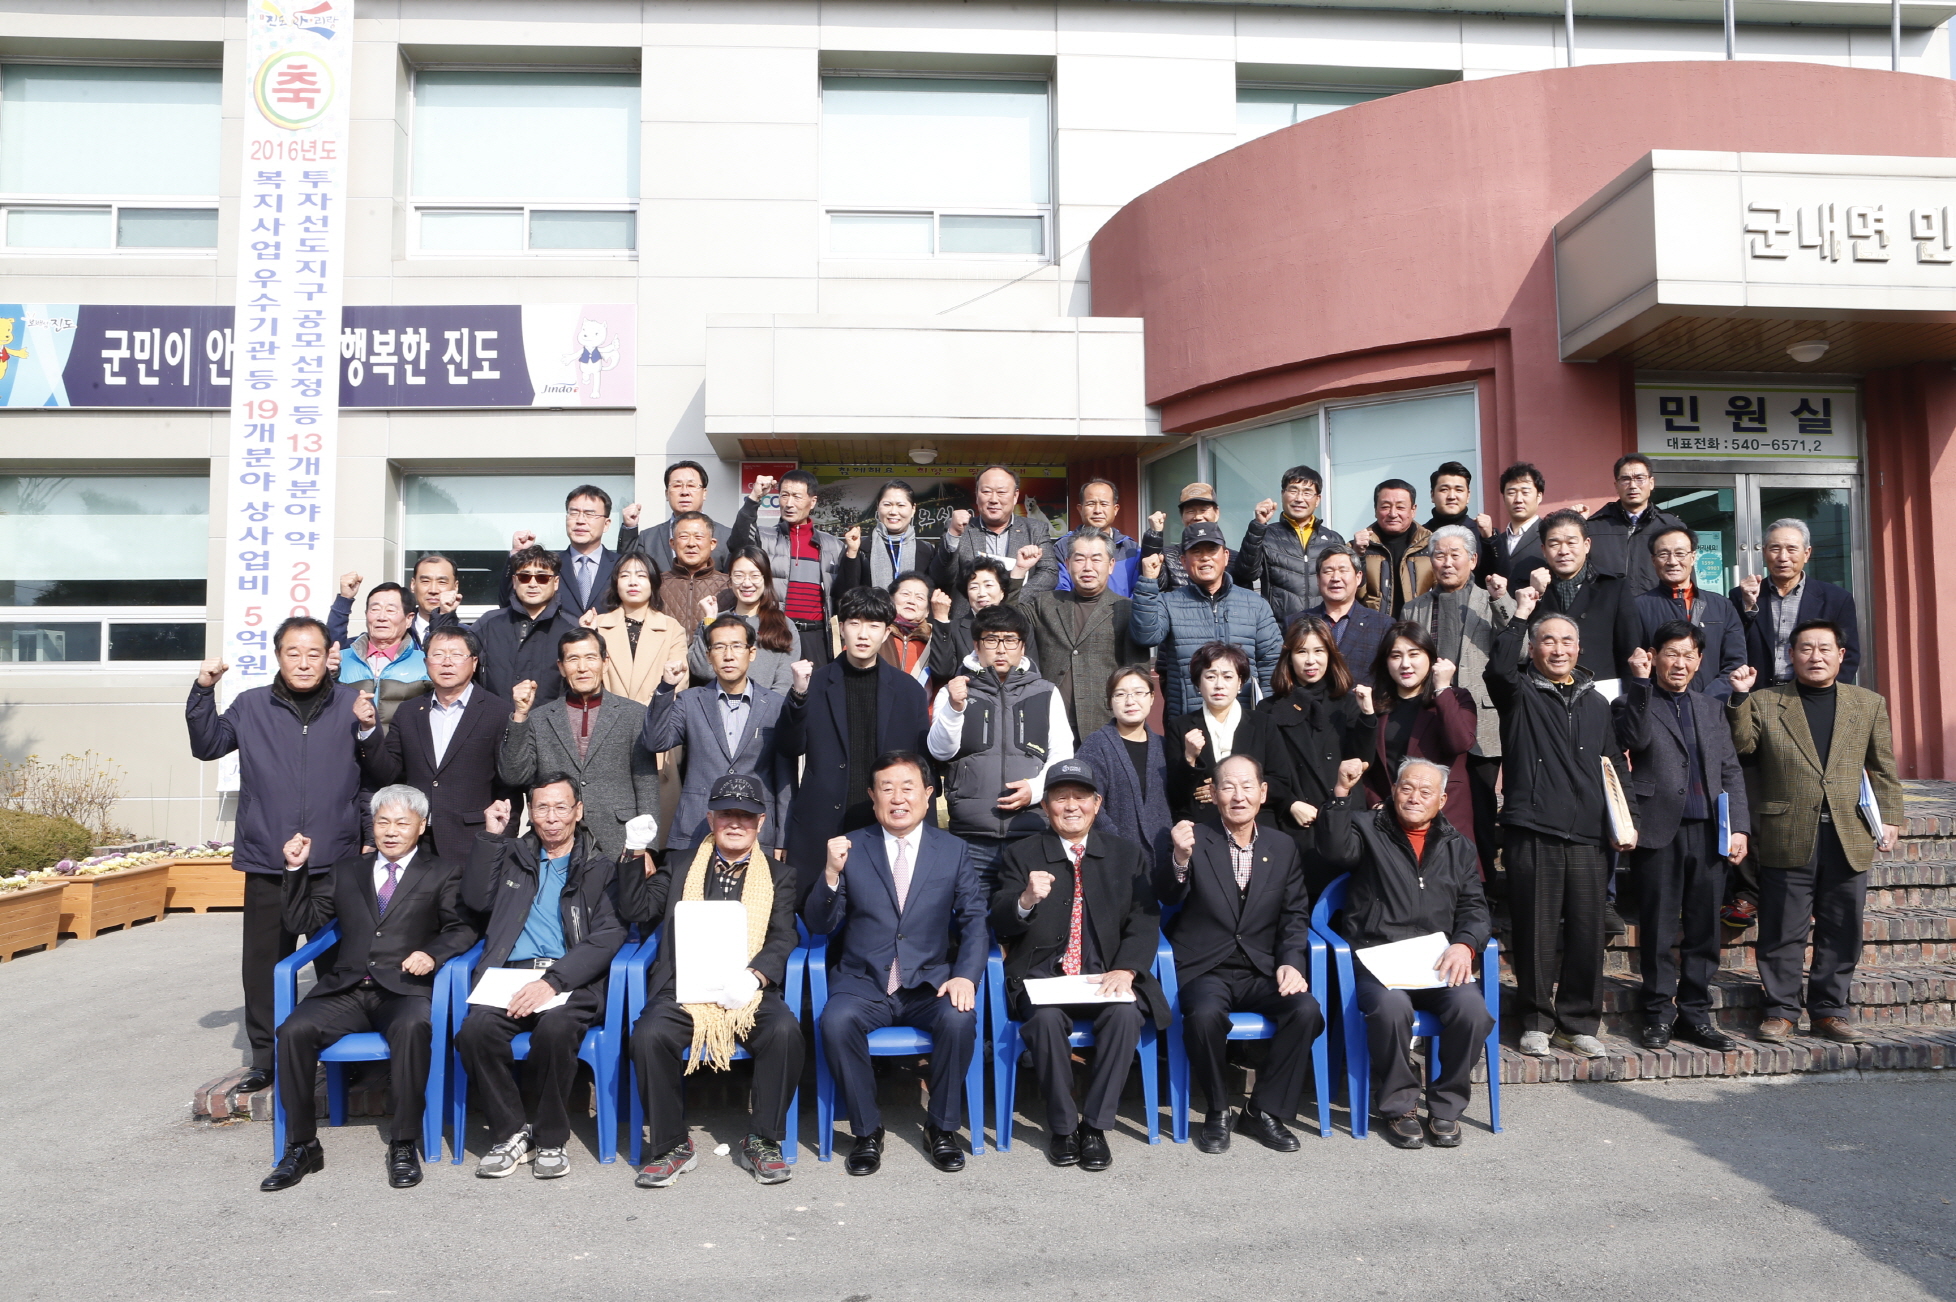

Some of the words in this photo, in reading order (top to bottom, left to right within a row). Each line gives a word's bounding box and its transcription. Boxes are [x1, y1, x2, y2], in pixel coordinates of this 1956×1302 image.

[272, 64, 321, 109] 축
[250, 139, 337, 162] 2016년도
[1744, 201, 1892, 262] 군내면
[50, 318, 78, 332] 진도
[101, 328, 192, 386] 군민이
[340, 328, 430, 387] 행복한
[442, 328, 500, 385] 진도
[541, 384, 573, 394] Jindo
[284, 531, 320, 550] 약
